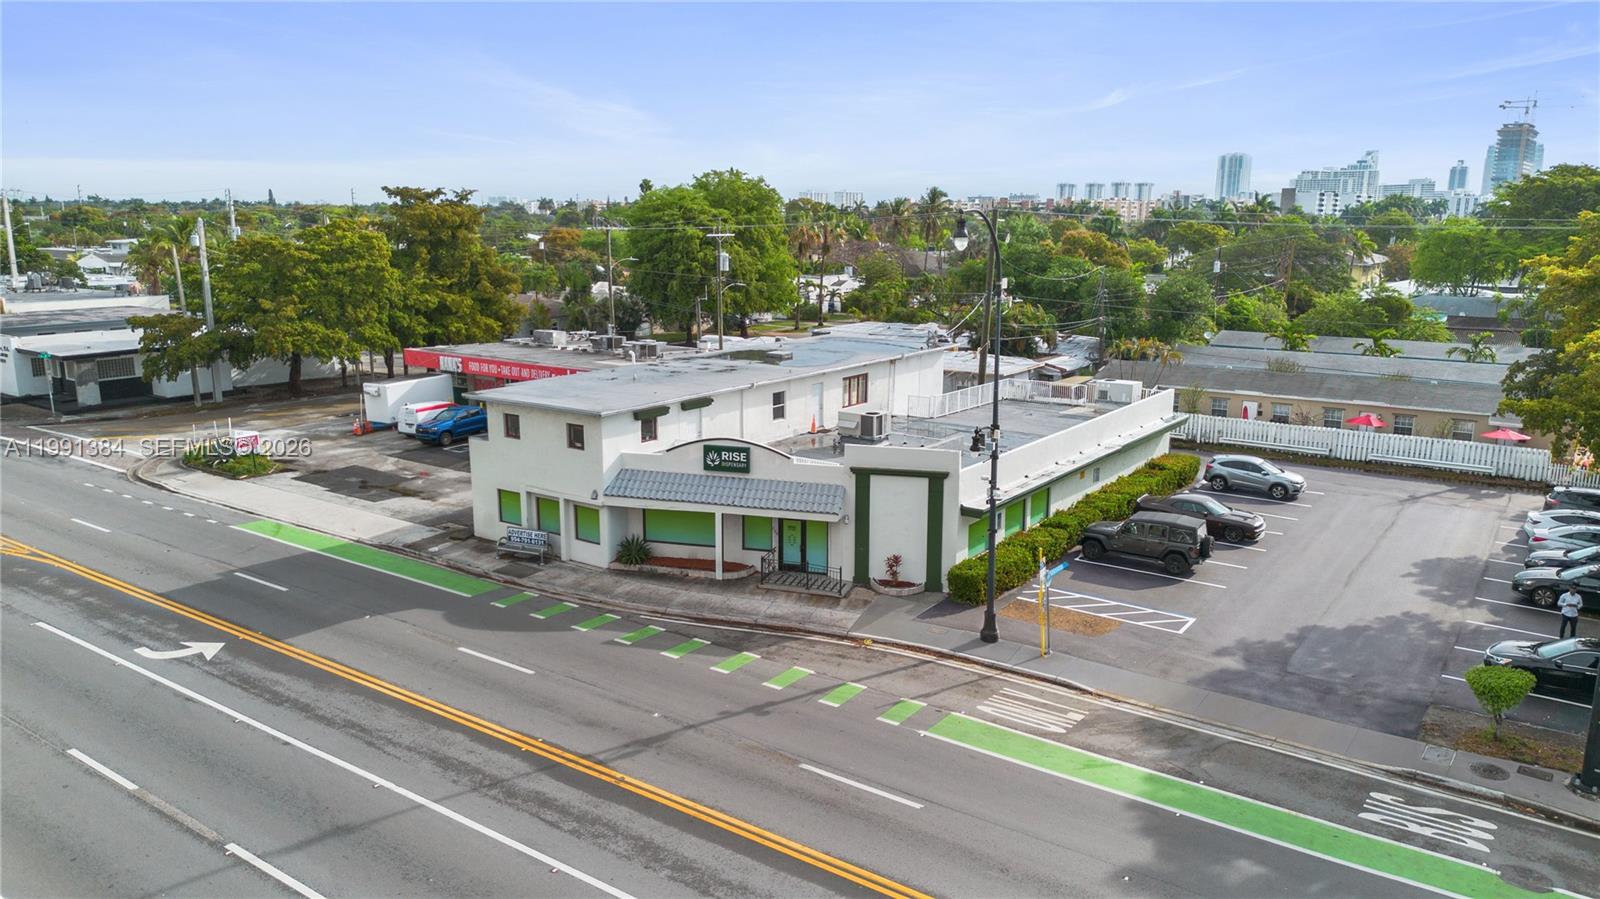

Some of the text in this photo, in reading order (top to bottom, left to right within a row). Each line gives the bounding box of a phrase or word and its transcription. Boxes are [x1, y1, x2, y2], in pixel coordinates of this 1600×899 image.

[468, 361, 480, 372] FOOD
[480, 362, 489, 373] FOR
[489, 363, 498, 374] YOU
[500, 365, 511, 376] TAKE
[511, 366, 520, 377] OUT
[521, 367, 530, 378] AND
[721, 451, 747, 462] RISE
[508, 529, 546, 540] ADVERTISE HERE
[1357, 791, 1498, 853] BUS
